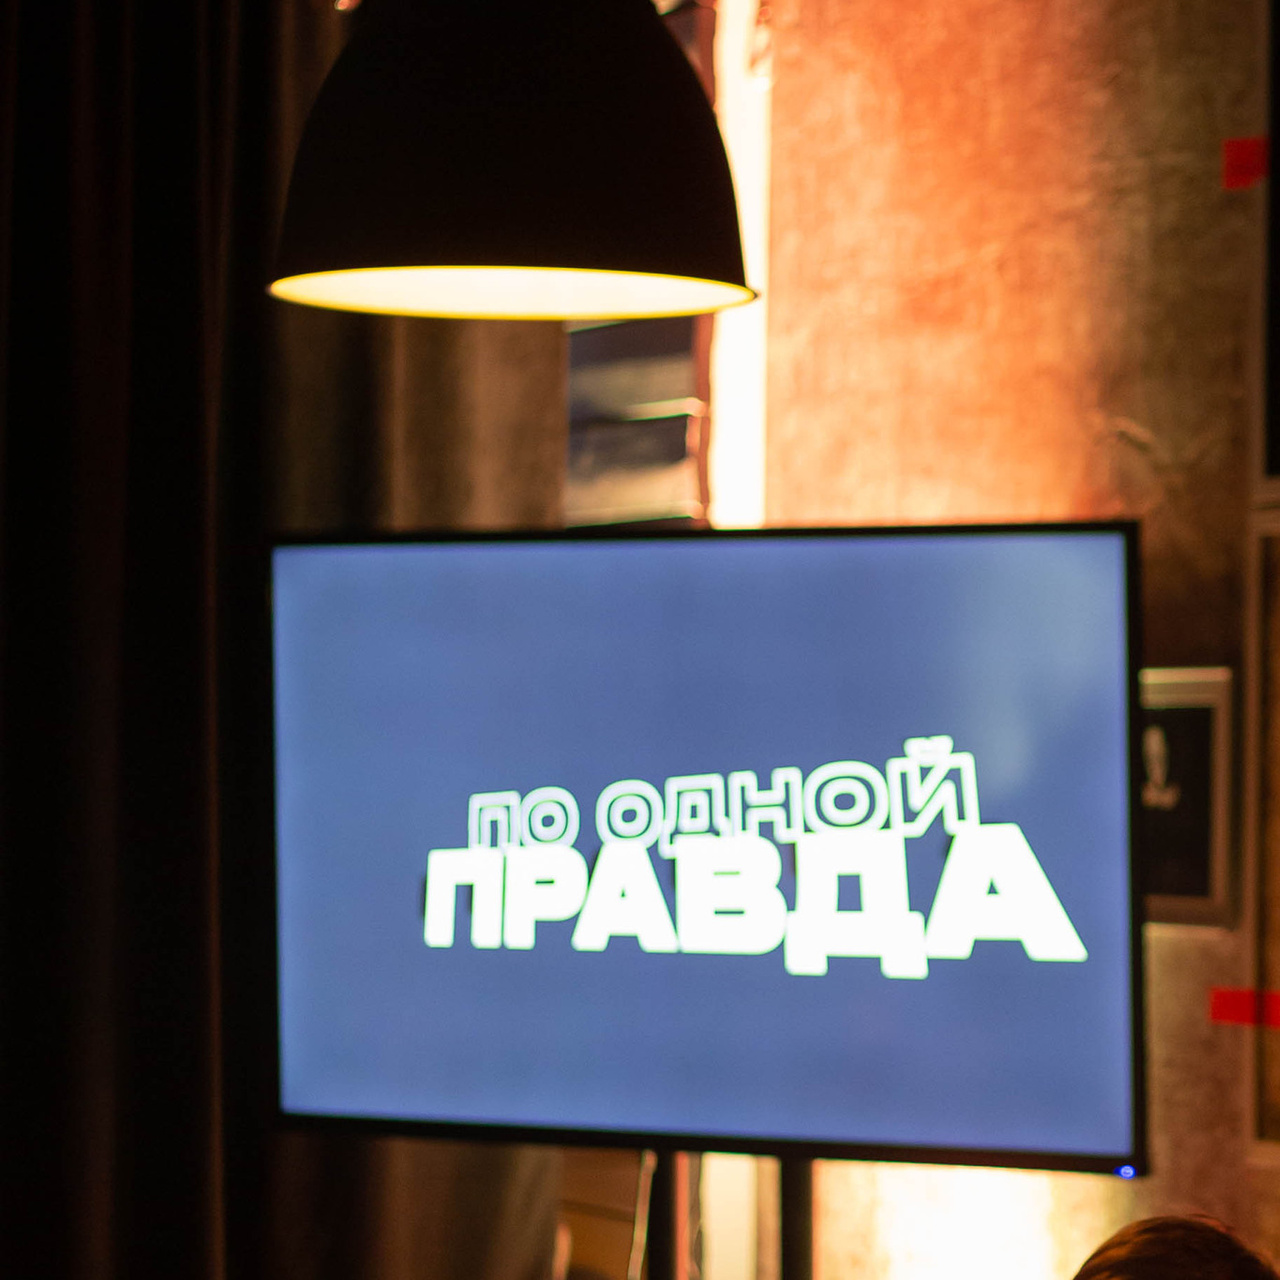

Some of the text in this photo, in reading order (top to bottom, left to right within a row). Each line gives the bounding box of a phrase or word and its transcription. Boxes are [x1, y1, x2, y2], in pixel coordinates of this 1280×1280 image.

[468, 735, 982, 858] ПО ОДНОЙ
[424, 822, 1089, 979] ПРАВДА
